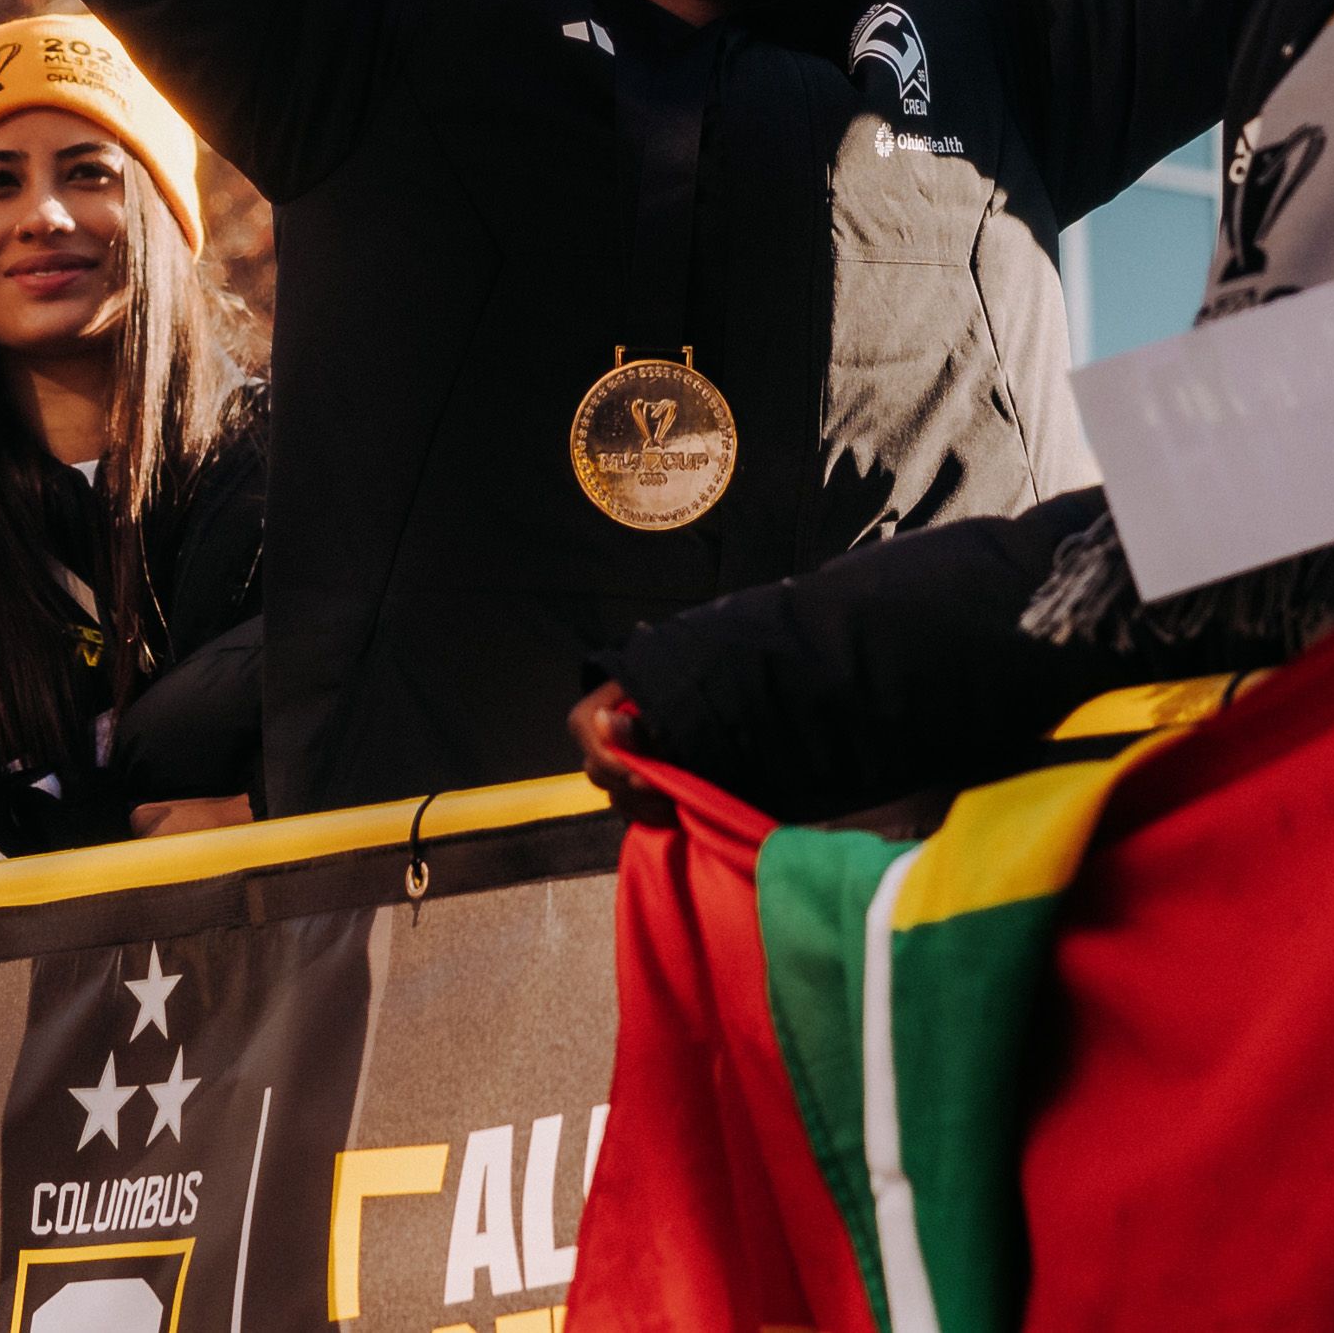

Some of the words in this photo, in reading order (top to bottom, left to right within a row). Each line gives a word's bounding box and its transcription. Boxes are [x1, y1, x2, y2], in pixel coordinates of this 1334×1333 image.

[903, 98, 928, 116] CREW
[897, 133, 964, 154] OhioHealth
[31, 1170, 204, 1236] COLUMBUS
[444, 1104, 612, 1305] AL
